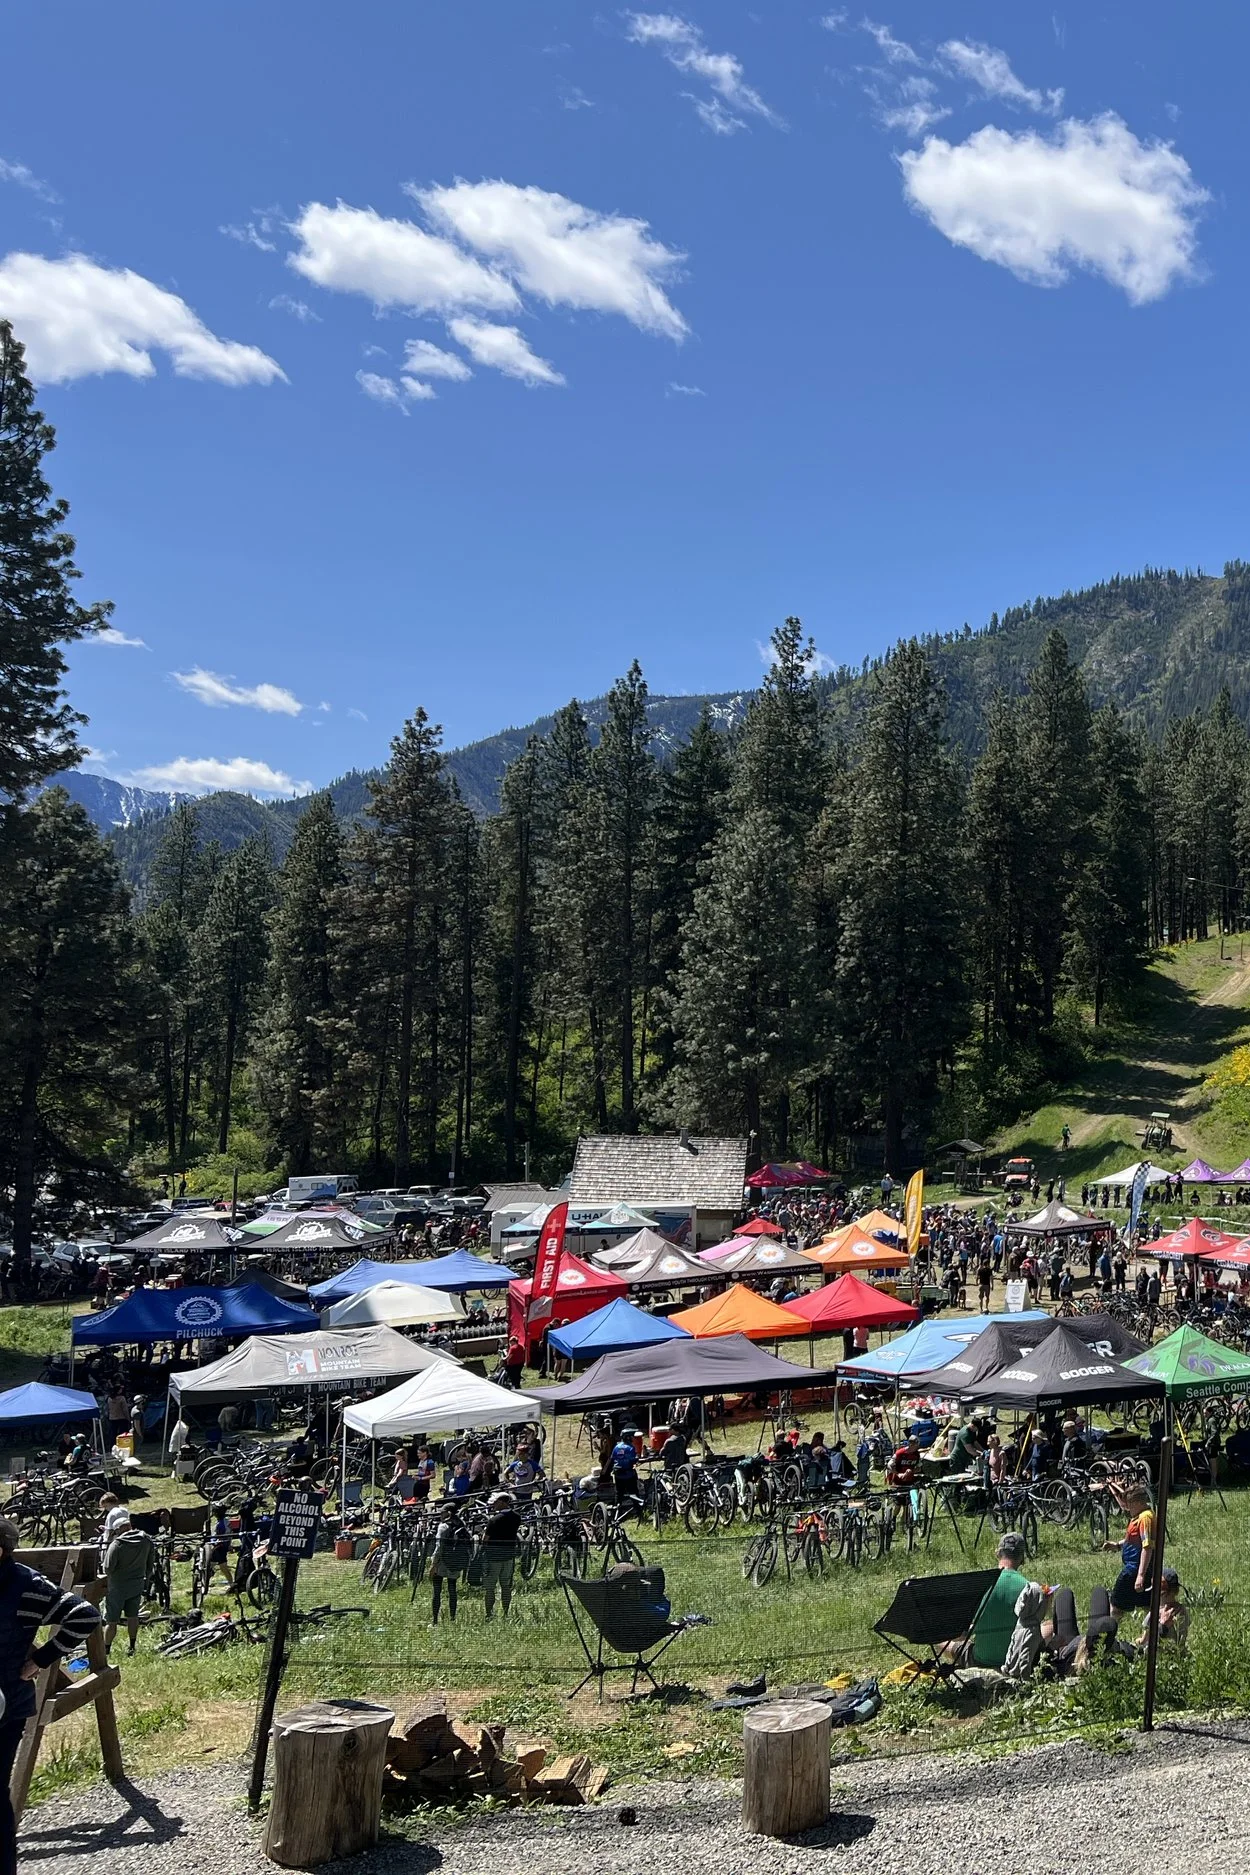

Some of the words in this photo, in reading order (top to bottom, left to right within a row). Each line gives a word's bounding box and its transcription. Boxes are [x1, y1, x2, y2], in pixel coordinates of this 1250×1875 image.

[546, 1237, 558, 1256] AID
[541, 1260, 555, 1289] FIRST
[176, 1327, 224, 1338] PILCHUCK
[318, 1345, 358, 1359] MONROE
[320, 1359, 360, 1367] MOUNTAIN
[1059, 1366, 1115, 1380] BOOGER
[318, 1380, 351, 1392] MOUNTAIN
[353, 1378, 367, 1388] BIKE
[369, 1376, 387, 1386] TEAM
[1186, 1385, 1221, 1399] Seattle
[294, 1493, 308, 1504] NO
[278, 1503, 319, 1516] ALCOHOL
[279, 1515, 314, 1527] BEYOND
[285, 1526, 305, 1537] THIS
[280, 1537, 307, 1548] POINT
